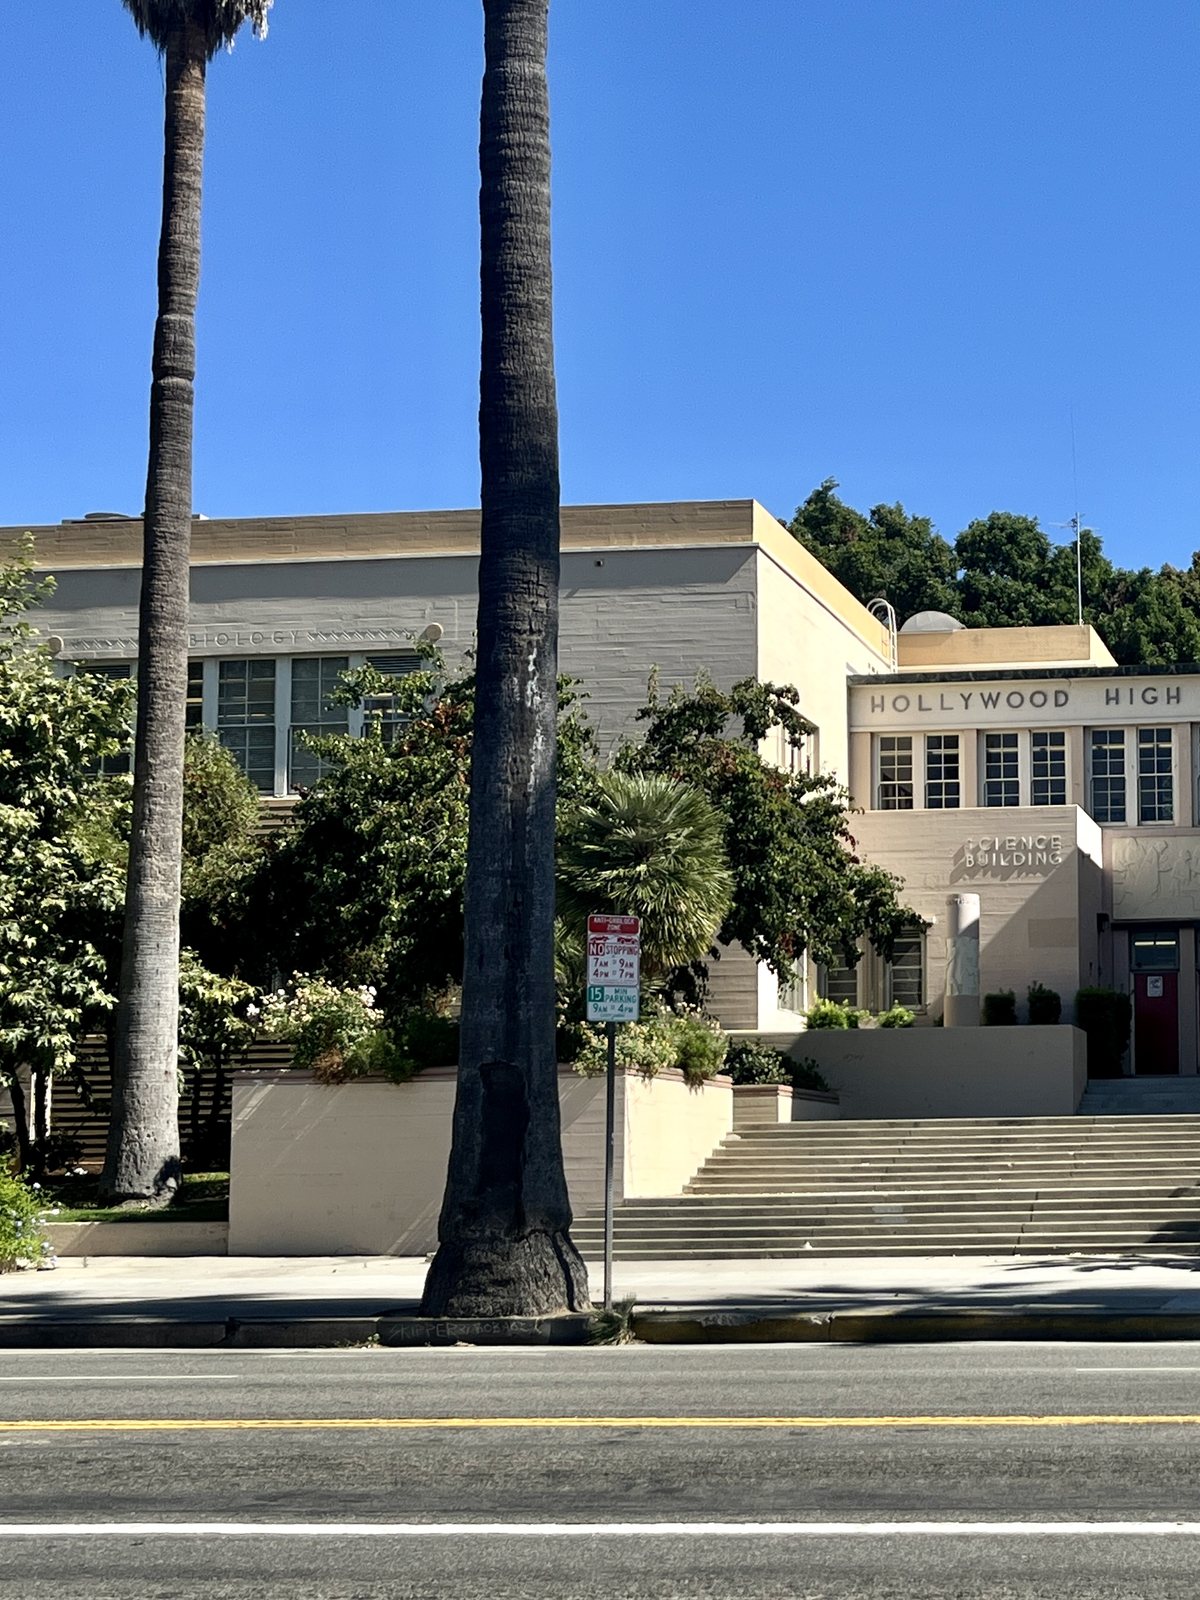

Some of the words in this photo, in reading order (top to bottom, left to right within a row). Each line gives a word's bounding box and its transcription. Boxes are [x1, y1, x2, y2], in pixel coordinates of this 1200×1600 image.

[187, 629, 299, 648] BIOLOGY
[871, 689, 1070, 713] HOLLYWOOD
[1105, 686, 1181, 706] HIGH
[966, 835, 1062, 851] SCIENCE
[965, 851, 1063, 868] BUILDING
[589, 943, 604, 955] NO
[605, 945, 638, 956] STOPPING
[590, 986, 602, 1001] 15
[605, 994, 637, 1003] PARKING
